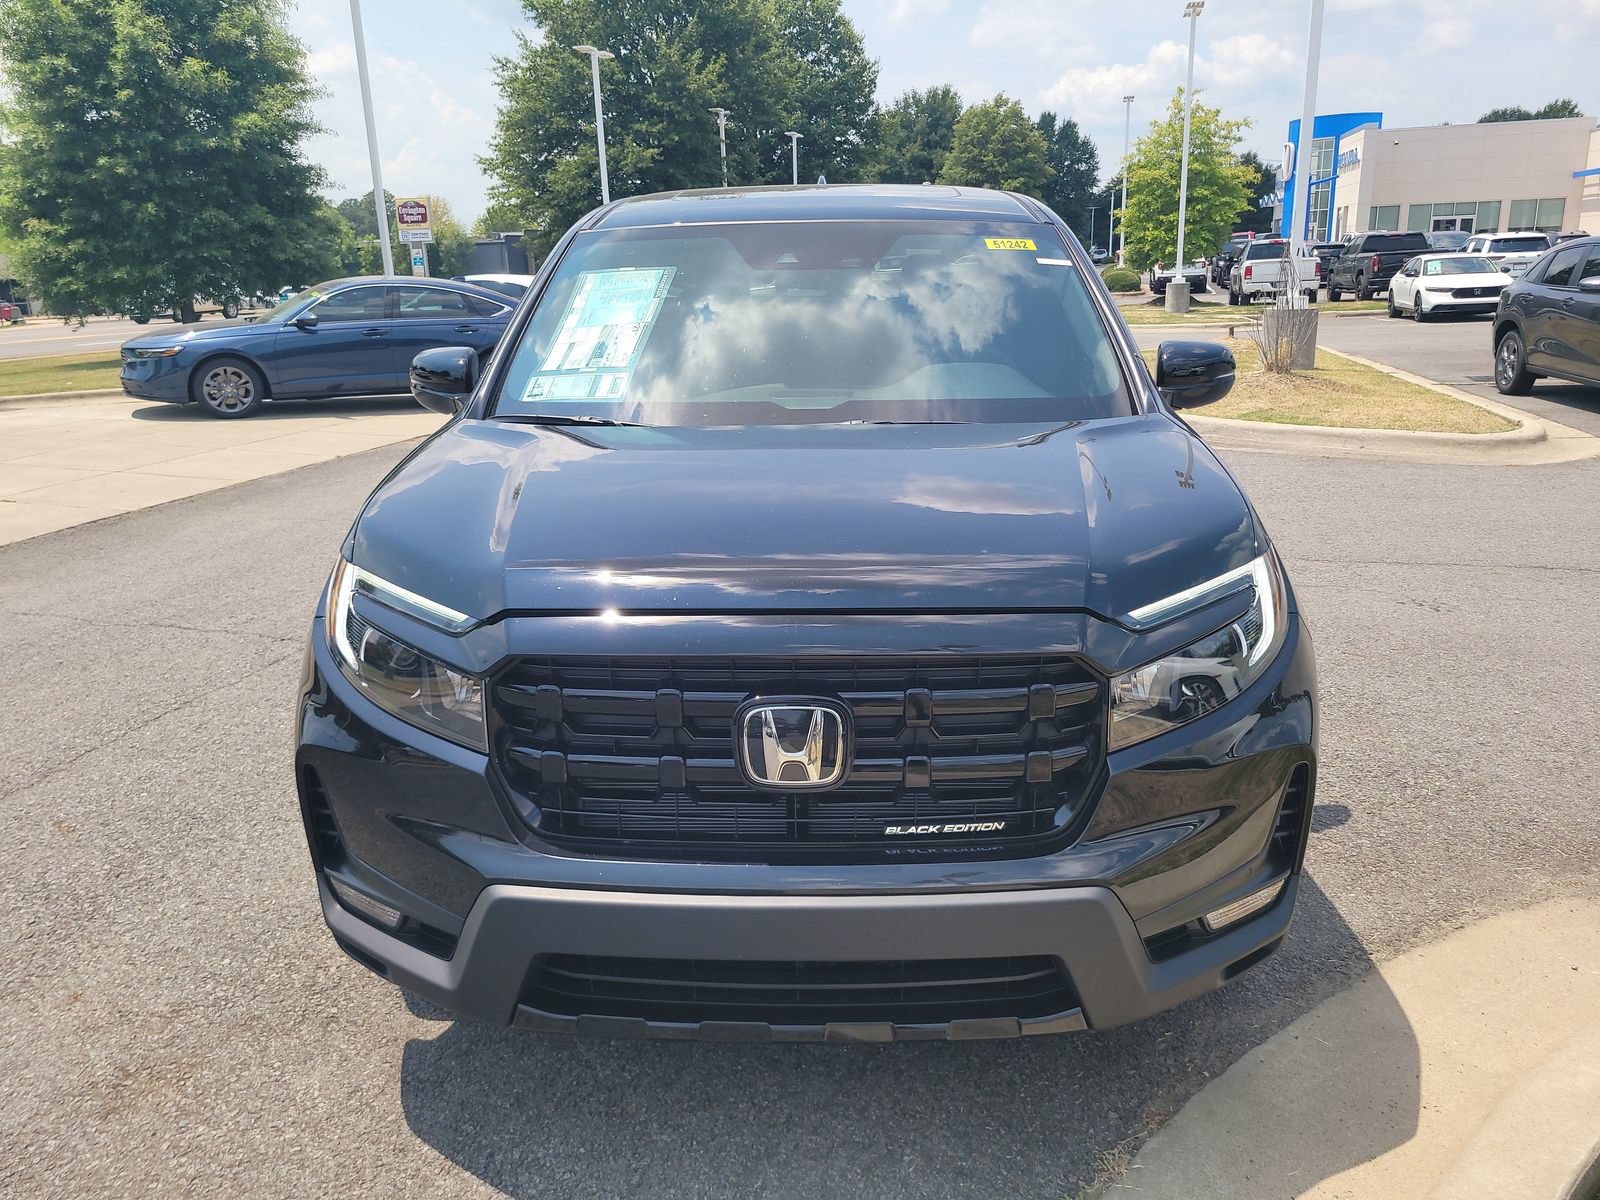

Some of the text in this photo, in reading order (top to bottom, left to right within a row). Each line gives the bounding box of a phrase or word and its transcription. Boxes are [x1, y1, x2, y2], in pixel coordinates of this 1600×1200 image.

[403, 214, 422, 223] Square
[993, 240, 1029, 248] 51242
[885, 821, 1005, 835] BLACK EDITION
